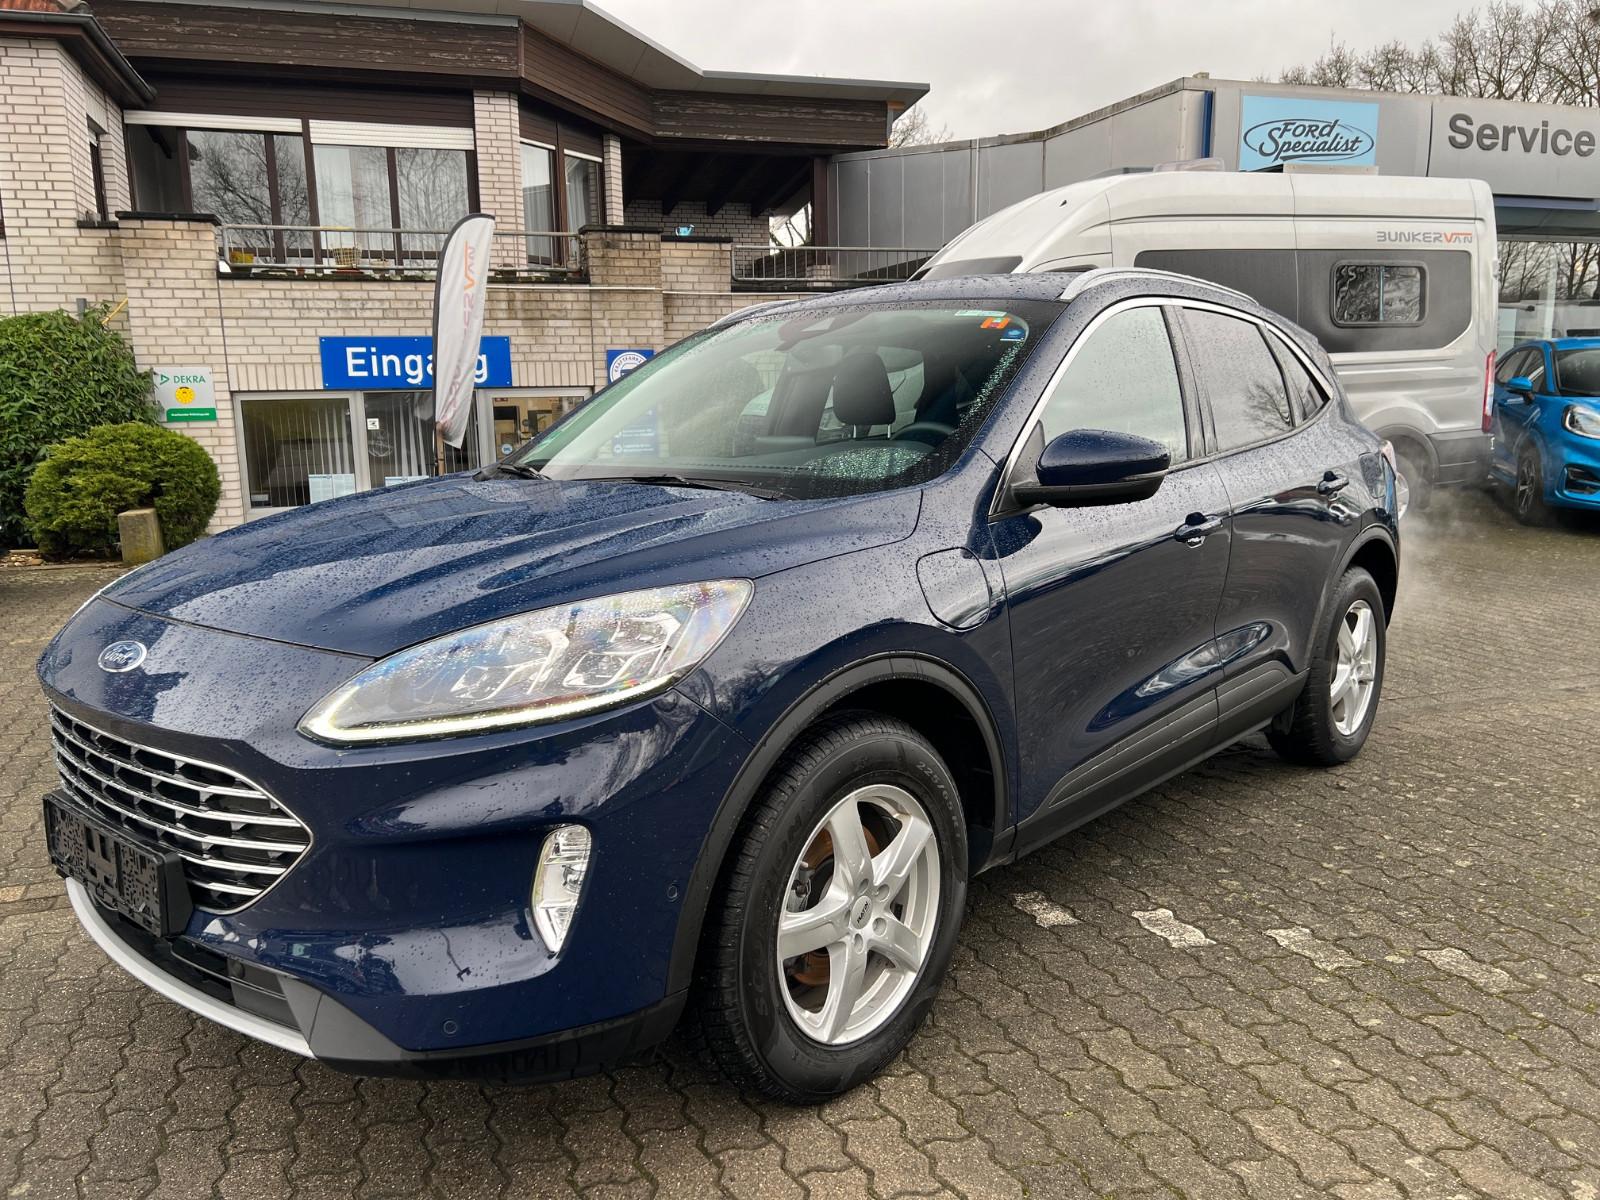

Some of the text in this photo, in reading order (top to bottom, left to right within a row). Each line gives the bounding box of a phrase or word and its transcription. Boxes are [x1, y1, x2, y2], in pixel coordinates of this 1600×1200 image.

[1258, 127, 1362, 162] Specialist
[1448, 113, 1596, 157] Service
[173, 375, 206, 384] DEKRA
[345, 346, 488, 384] Eingg
